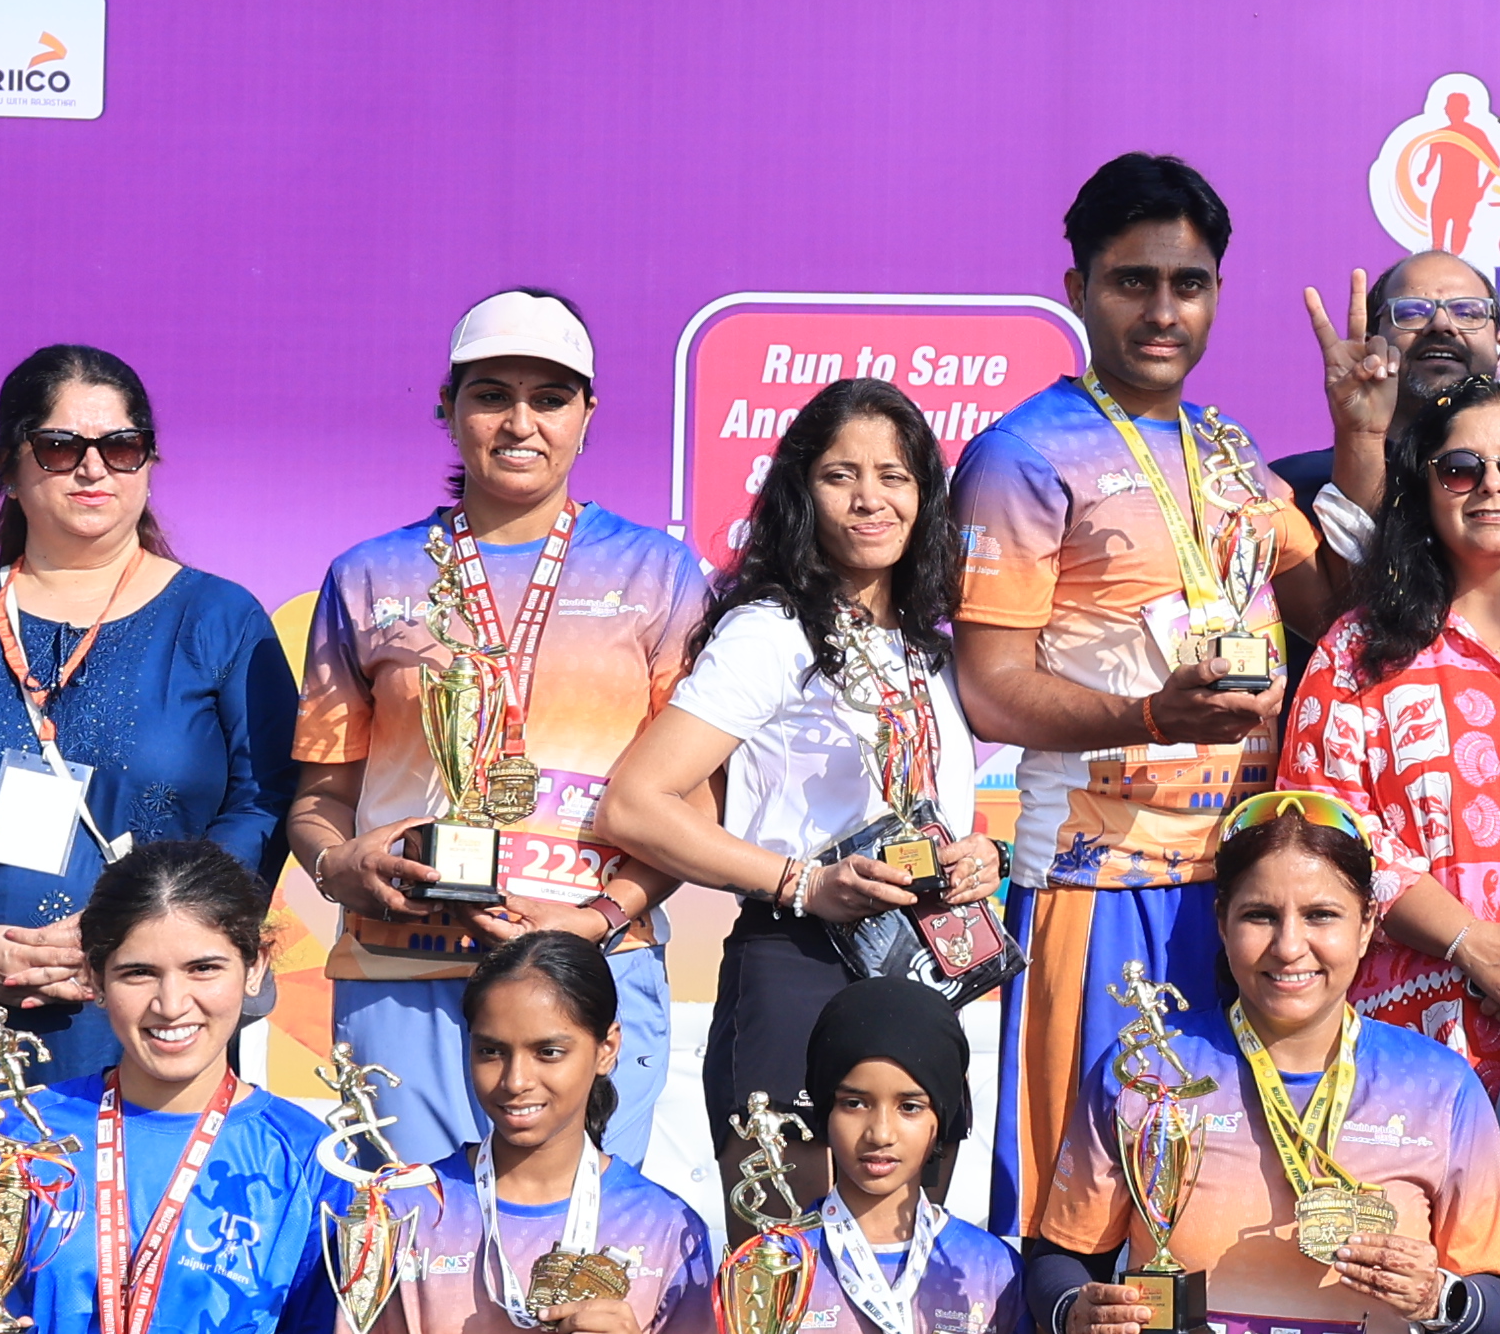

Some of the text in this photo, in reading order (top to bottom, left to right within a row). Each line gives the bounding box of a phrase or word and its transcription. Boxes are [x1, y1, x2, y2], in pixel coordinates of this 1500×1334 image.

[761, 343, 1008, 387] Run to Save
[521, 839, 622, 888] 2226
[177, 1255, 213, 1272] Jaipur
